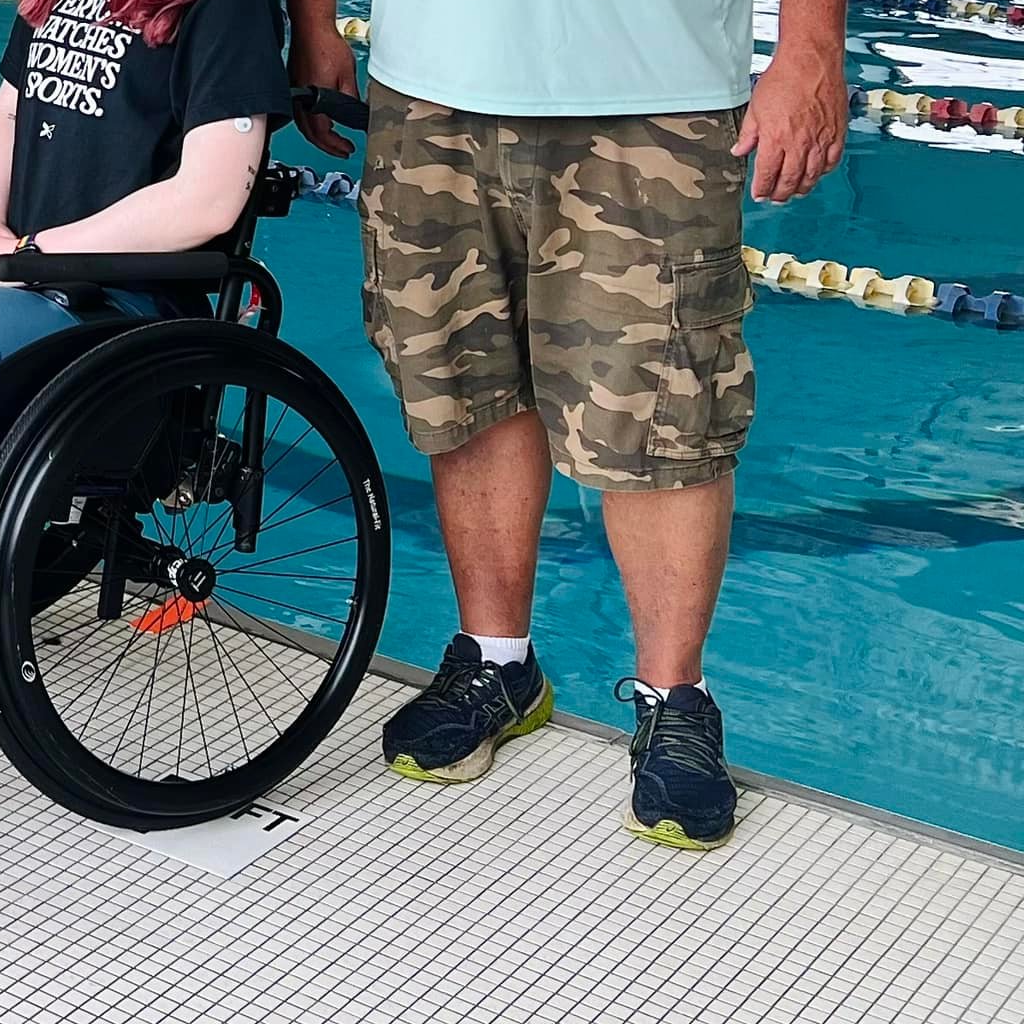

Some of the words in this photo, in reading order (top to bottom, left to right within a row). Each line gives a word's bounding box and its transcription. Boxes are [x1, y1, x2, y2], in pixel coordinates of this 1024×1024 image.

[27, 42, 121, 90] WOMEN'S
[25, 71, 104, 117] SPORTS.
[230, 802, 300, 832] FT
